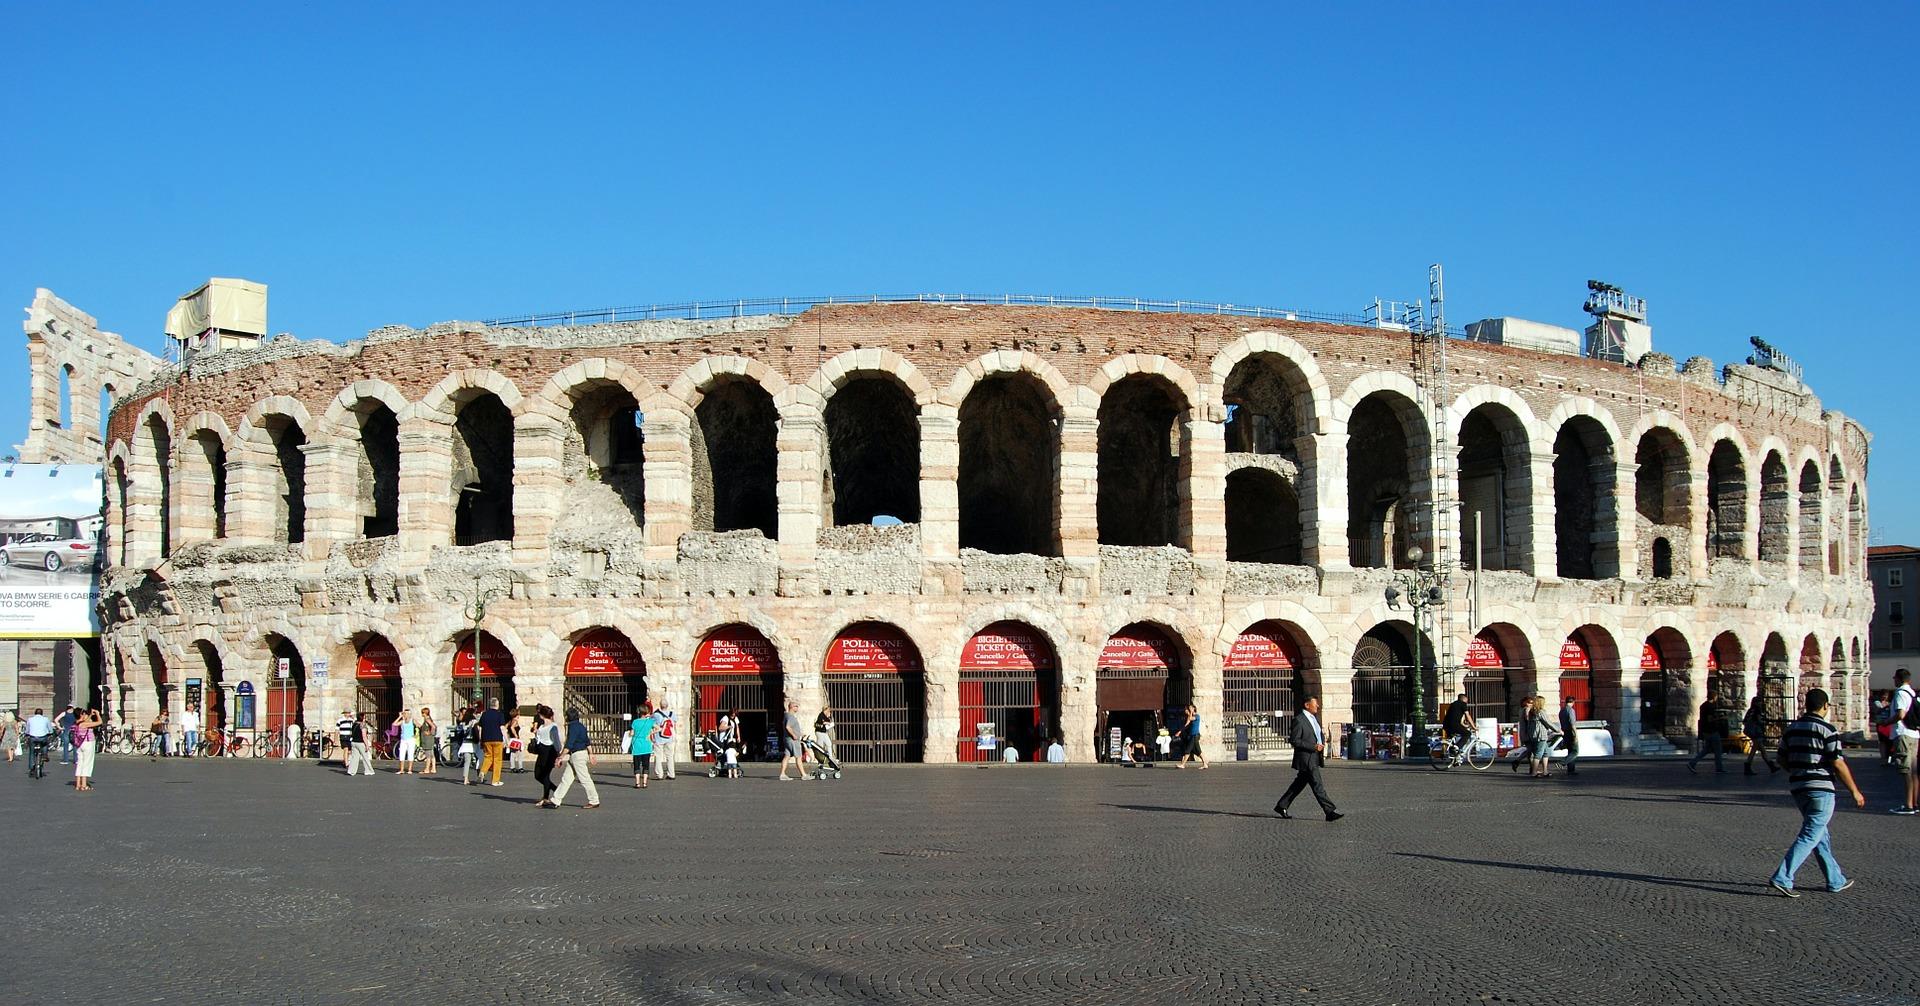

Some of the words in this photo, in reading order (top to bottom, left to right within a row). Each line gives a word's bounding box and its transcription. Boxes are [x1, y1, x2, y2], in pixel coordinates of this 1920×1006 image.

[0, 592, 13, 600] VA
[14, 592, 36, 600] BMW
[38, 592, 63, 600] SERIE
[64, 592, 69, 600] 6
[978, 635, 1032, 643] BIGLIETTERIA
[713, 640, 767, 648] BIGLIETTERIA
[842, 640, 903, 648] POLTRONE
[976, 643, 1004, 651] TICKET
[1005, 643, 1034, 651] OFFICE
[467, 652, 491, 660] Cacello
[709, 655, 740, 663] Cancello
[843, 653, 870, 661] Entrata
